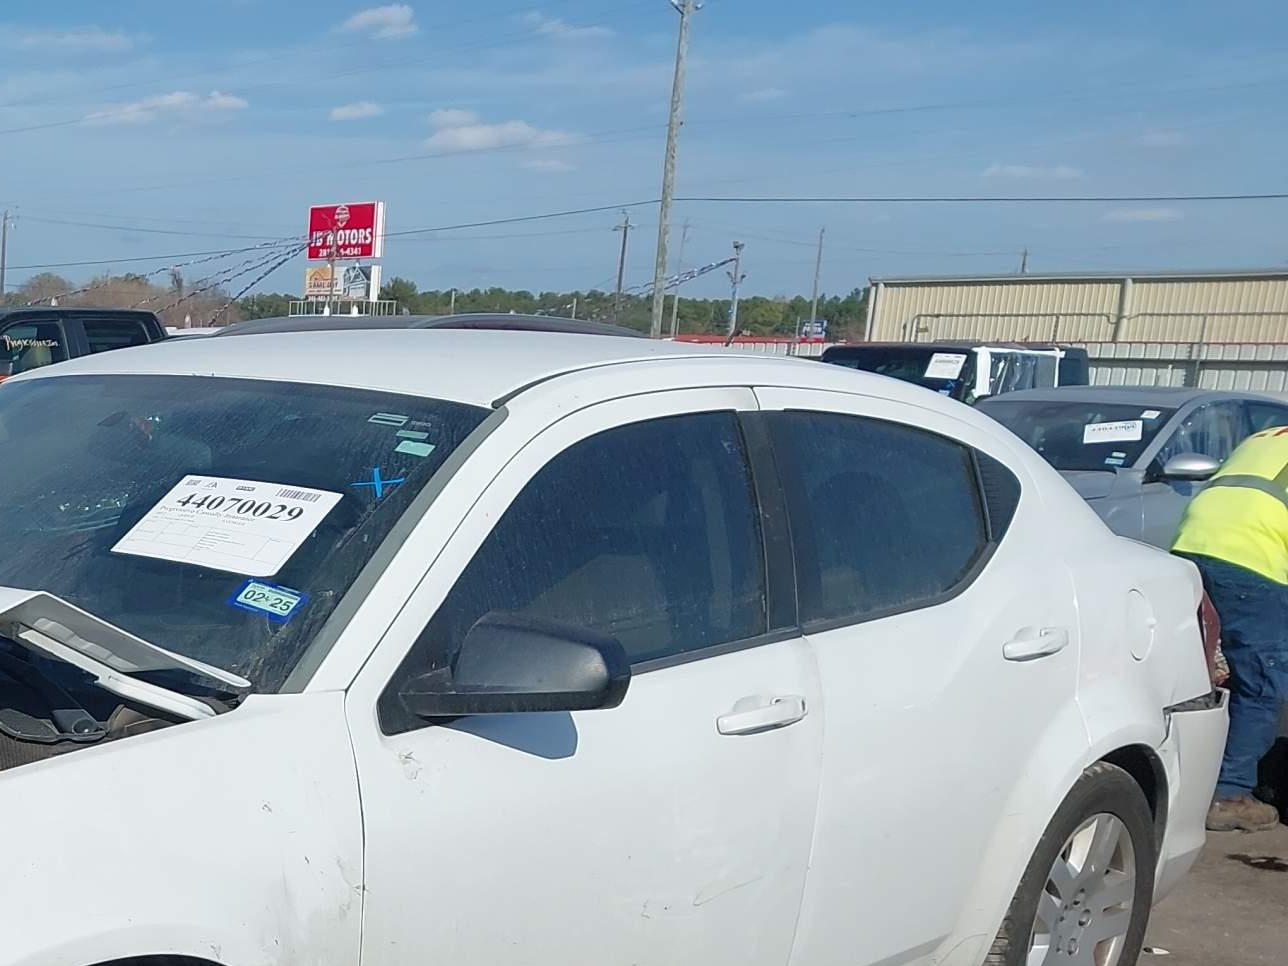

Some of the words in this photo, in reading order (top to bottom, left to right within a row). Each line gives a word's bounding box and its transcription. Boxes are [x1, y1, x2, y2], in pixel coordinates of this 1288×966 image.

[326, 228, 372, 246] MOTORS
[176, 492, 304, 522] 44070029
[244, 589, 266, 603] 02
[269, 597, 294, 611] 25
